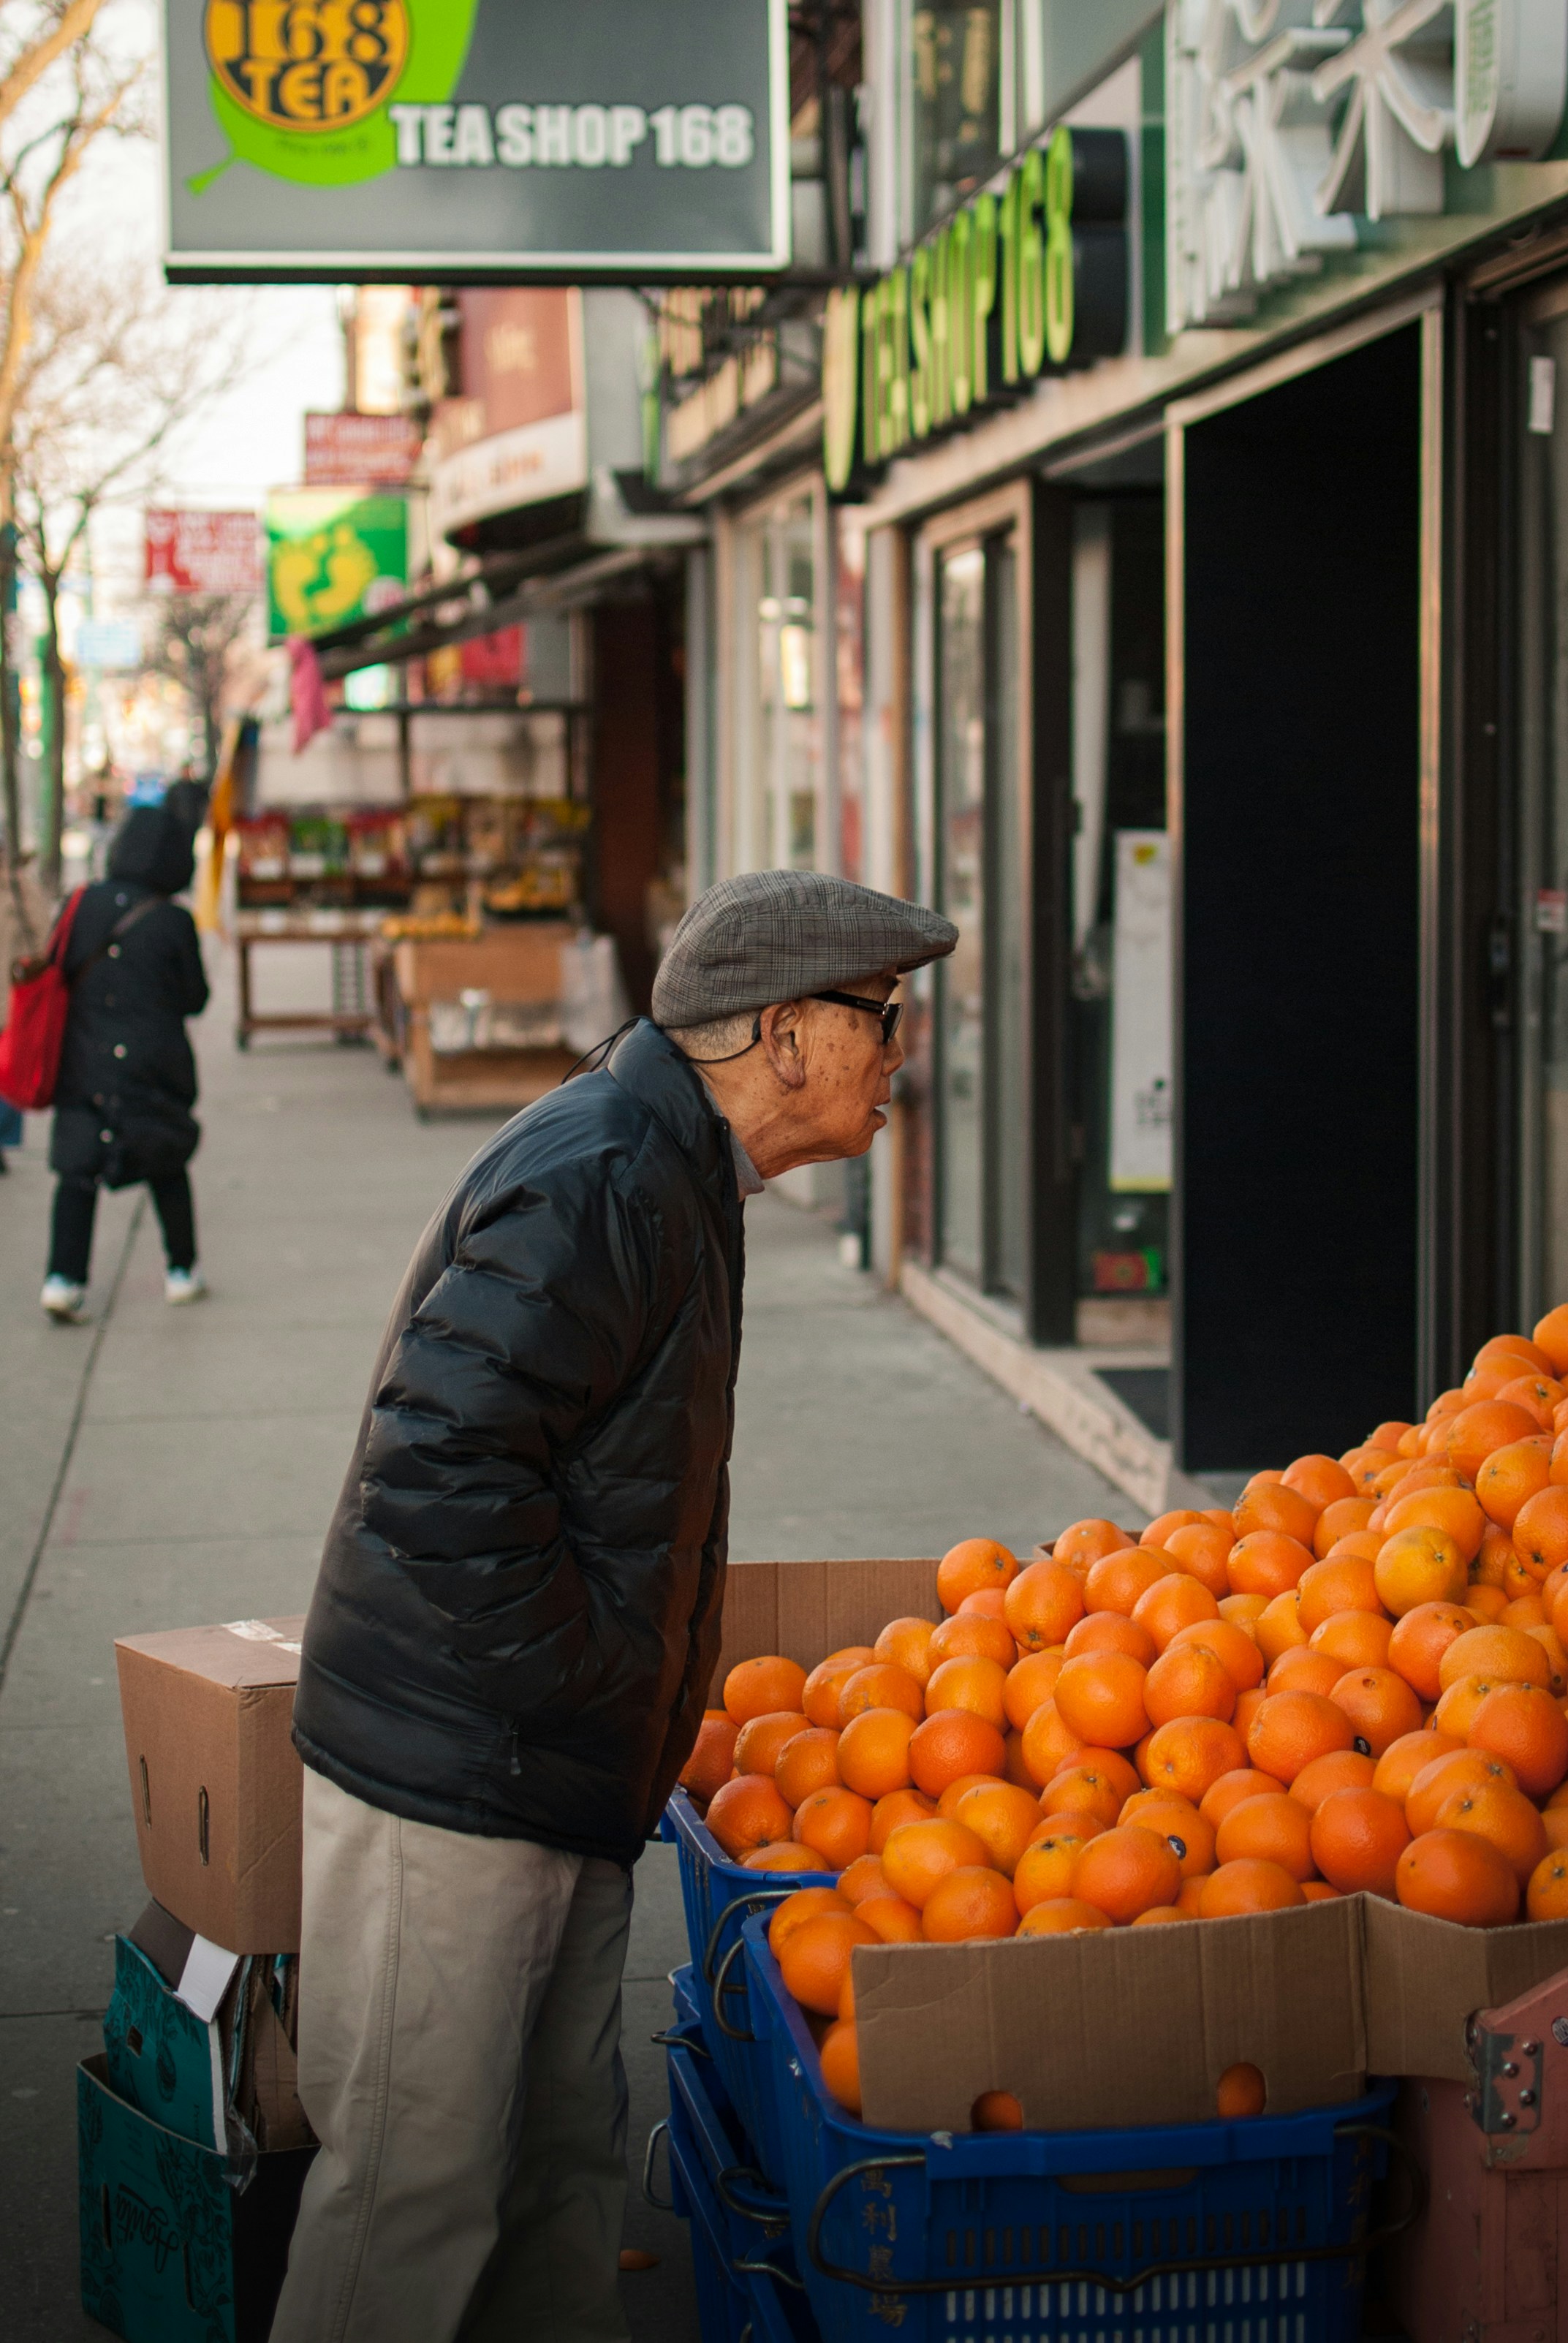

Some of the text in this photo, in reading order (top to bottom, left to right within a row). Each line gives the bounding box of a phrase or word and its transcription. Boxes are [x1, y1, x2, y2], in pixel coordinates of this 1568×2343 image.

[238, 0, 387, 63] 168
[240, 58, 371, 118] TEA
[389, 104, 754, 167] TEA SHOP 168
[1000, 126, 1074, 385] 168
